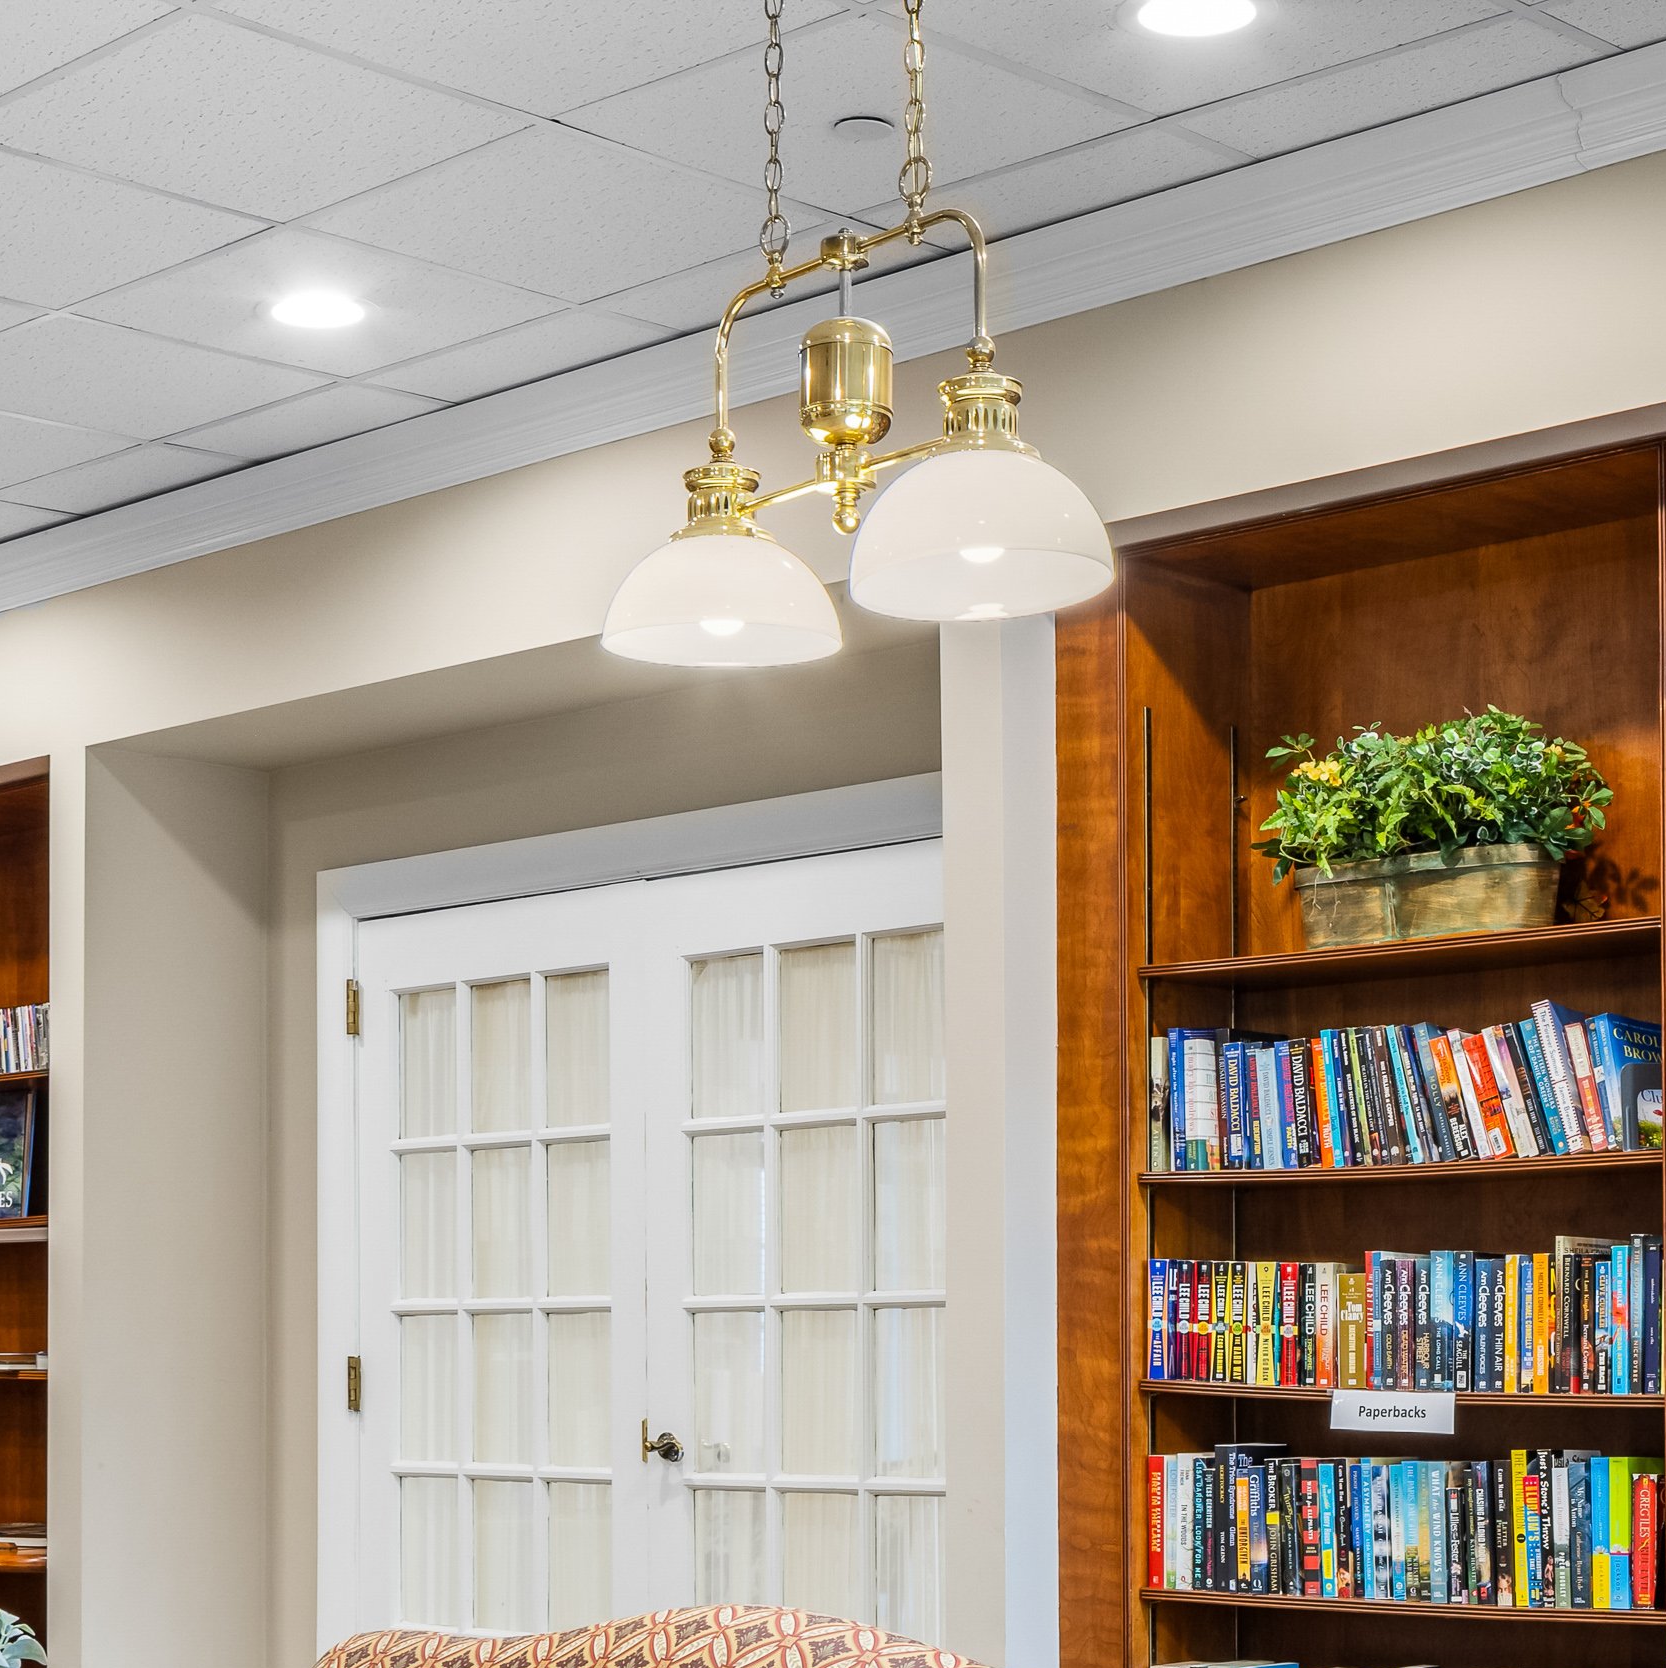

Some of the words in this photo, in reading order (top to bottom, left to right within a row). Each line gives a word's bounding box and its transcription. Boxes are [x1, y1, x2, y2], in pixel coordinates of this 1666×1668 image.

[1305, 1283, 1314, 1302] LEE
[1305, 1305, 1314, 1334] CHILD
[1495, 1333, 1503, 1352] THIN
[1495, 1354, 1503, 1372] AIR
[1358, 1406, 1426, 1420] Paperbacks
